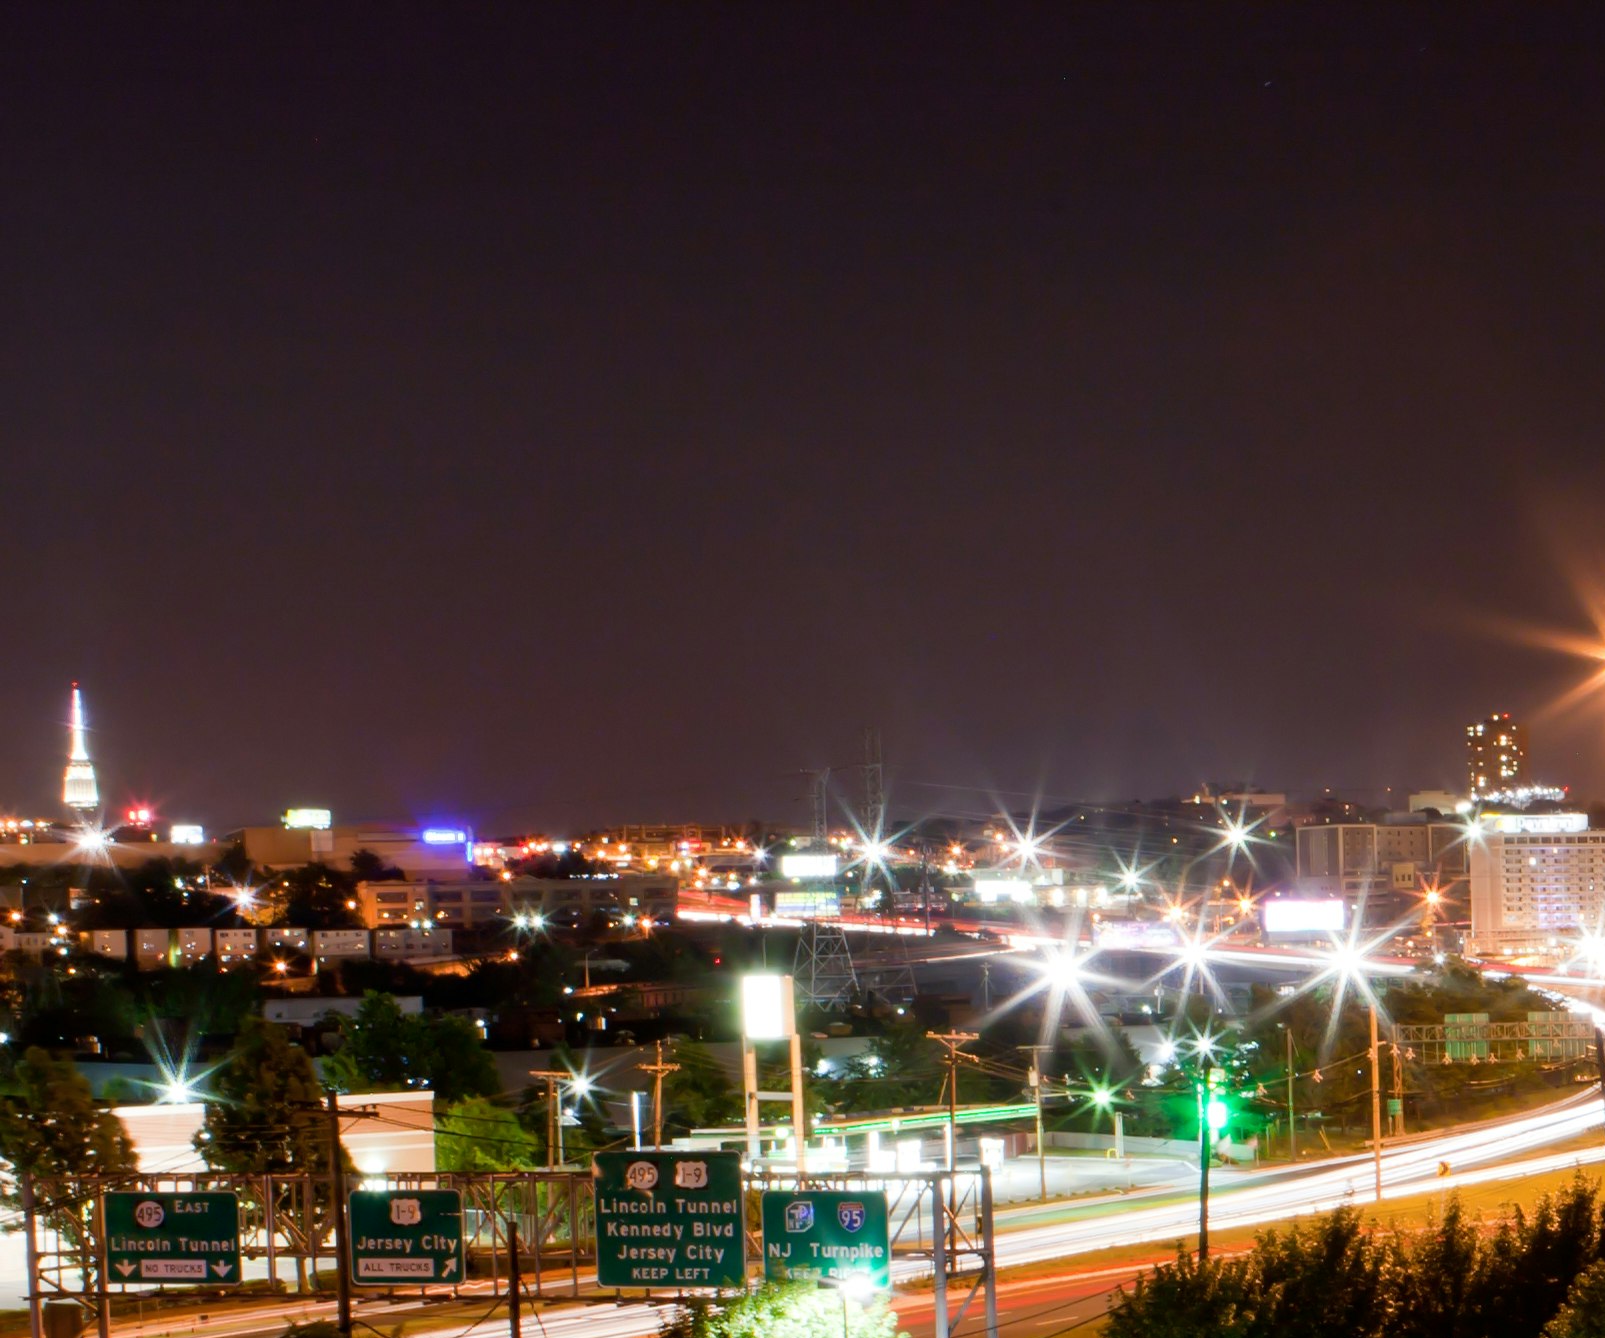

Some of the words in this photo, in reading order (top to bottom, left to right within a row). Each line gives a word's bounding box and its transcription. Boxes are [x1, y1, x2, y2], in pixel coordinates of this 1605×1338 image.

[629, 1167, 655, 1183] 495
[682, 1167, 702, 1183] 1-9
[137, 1206, 161, 1222] 495
[175, 1200, 210, 1213] EAST
[396, 1204, 416, 1220] 1-9
[600, 1198, 667, 1213] Lincoln
[675, 1199, 737, 1214] Tunnel
[841, 1210, 861, 1227] 95
[607, 1222, 684, 1240] Kennedy
[693, 1222, 734, 1237] Blvd
[111, 1237, 171, 1252] Lincoln
[177, 1237, 236, 1252] Tunnel
[357, 1236, 413, 1253] Jersey
[421, 1235, 458, 1253] City
[617, 1245, 677, 1264] Jersey
[686, 1244, 725, 1264] City
[768, 1243, 792, 1257] NJ
[809, 1243, 884, 1262] Turnpike
[145, 1264, 159, 1273] NO
[164, 1264, 203, 1273] TRUCKS
[363, 1263, 384, 1272] ALL
[389, 1263, 431, 1272] TRUCKS
[632, 1268, 669, 1280] KEEP
[675, 1268, 710, 1280] LEFT
